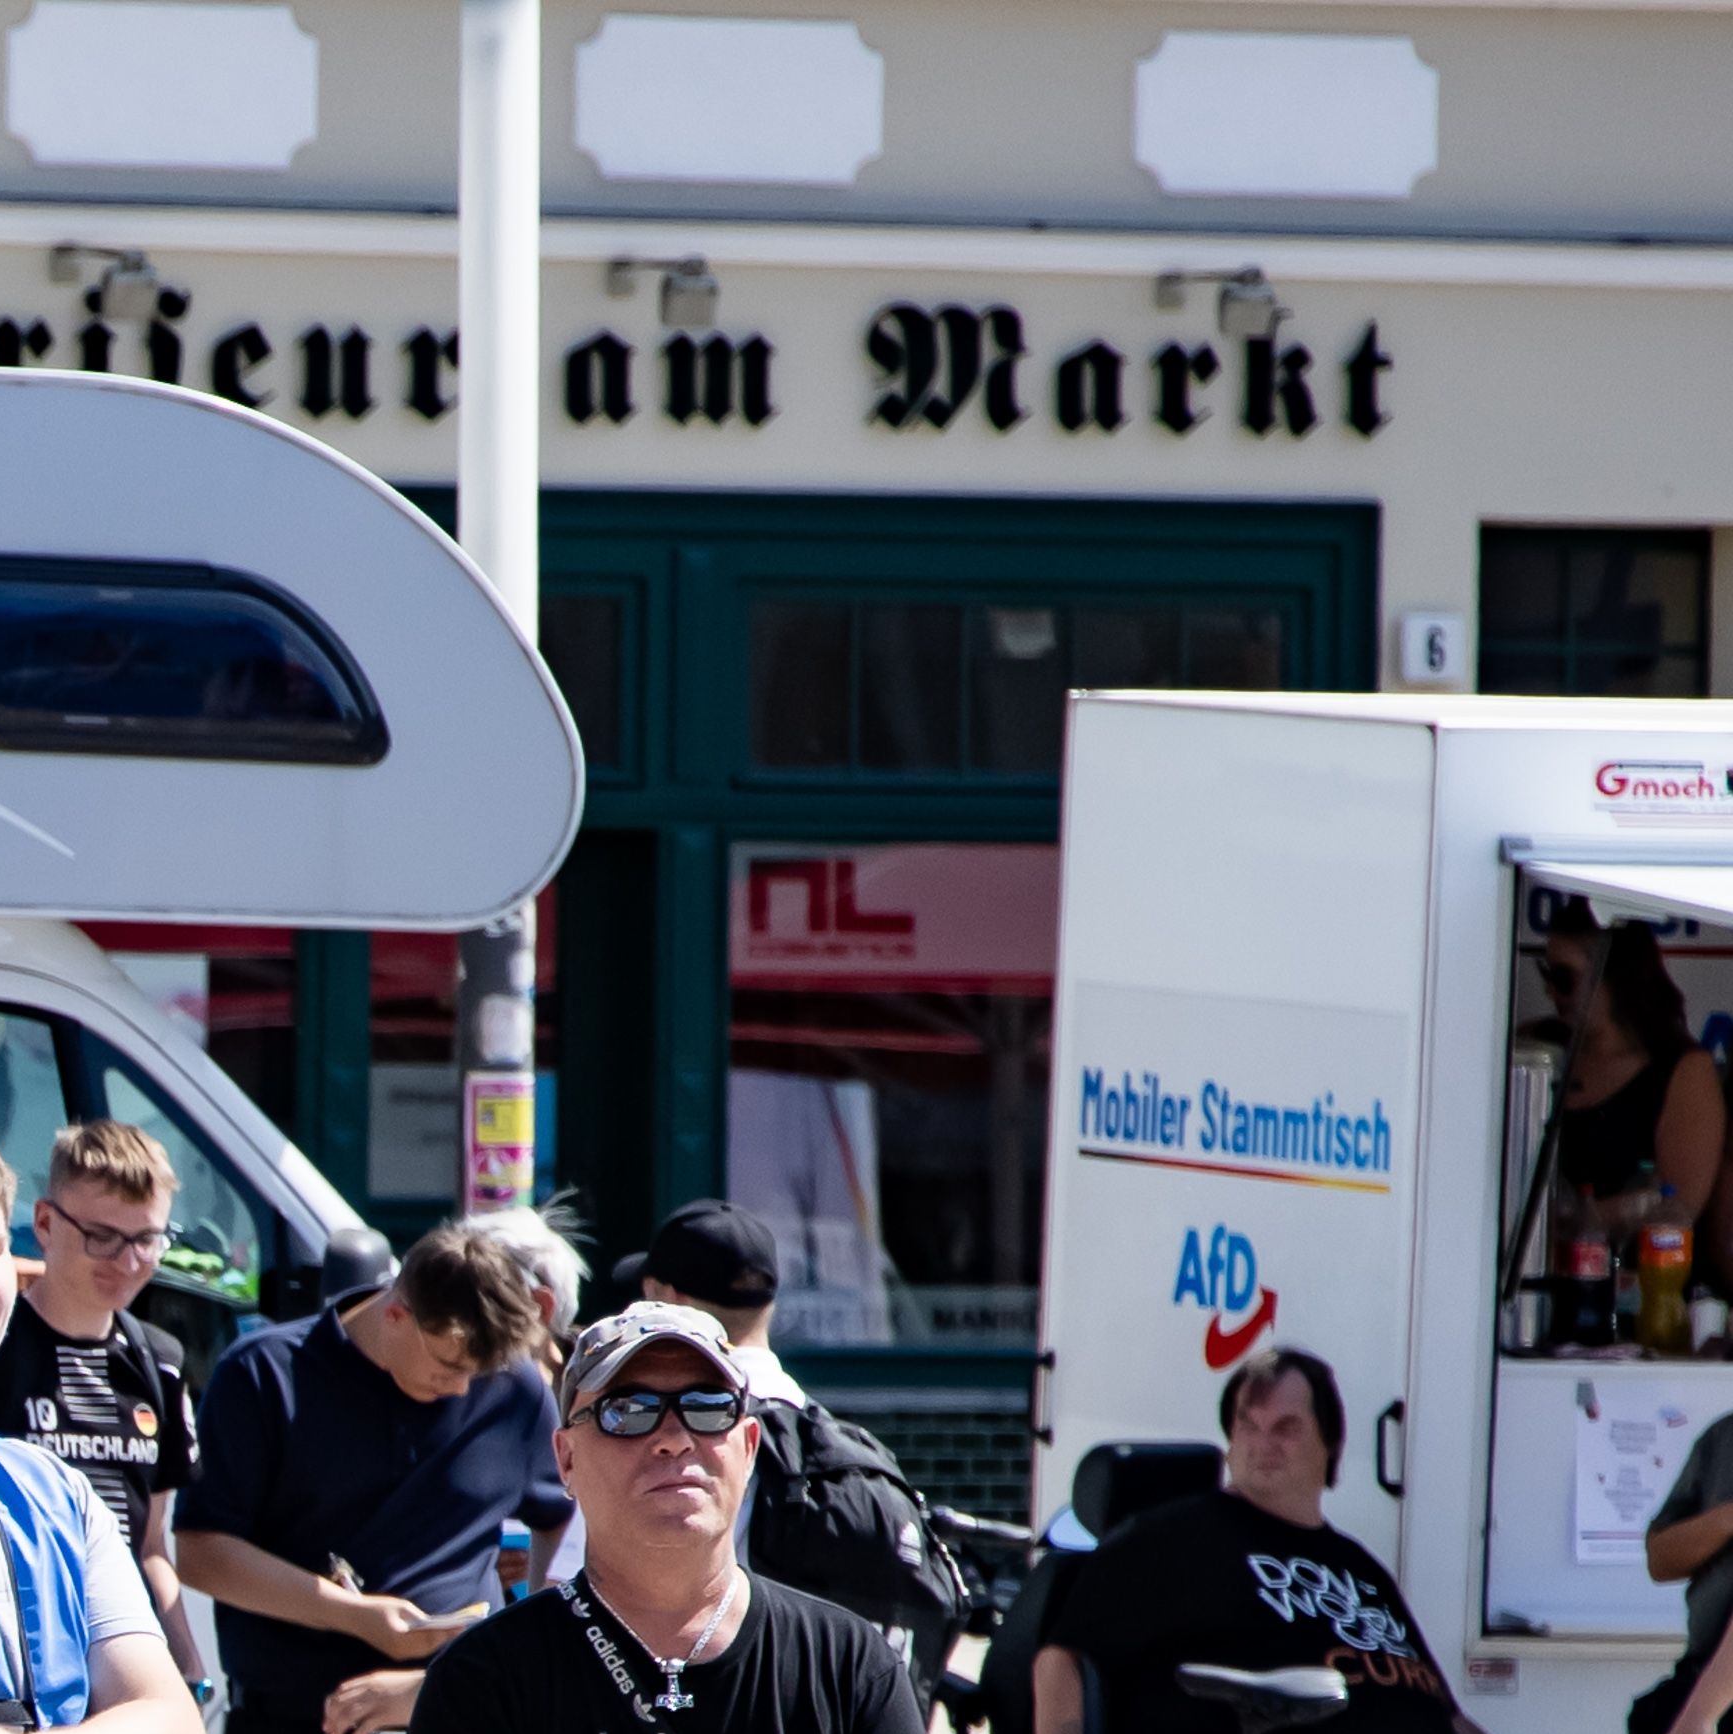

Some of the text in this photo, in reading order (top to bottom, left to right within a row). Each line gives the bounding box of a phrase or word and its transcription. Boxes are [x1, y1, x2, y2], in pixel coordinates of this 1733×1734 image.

[563, 328, 777, 428] am
[866, 300, 1394, 438] Markt
[1423, 628, 1446, 673] 6
[1080, 1065, 1391, 1174] Mobiler Stammtisch
[1174, 1222, 1258, 1312] AfD
[24, 1396, 59, 1432] 10
[586, 1625, 635, 1695] adidas
